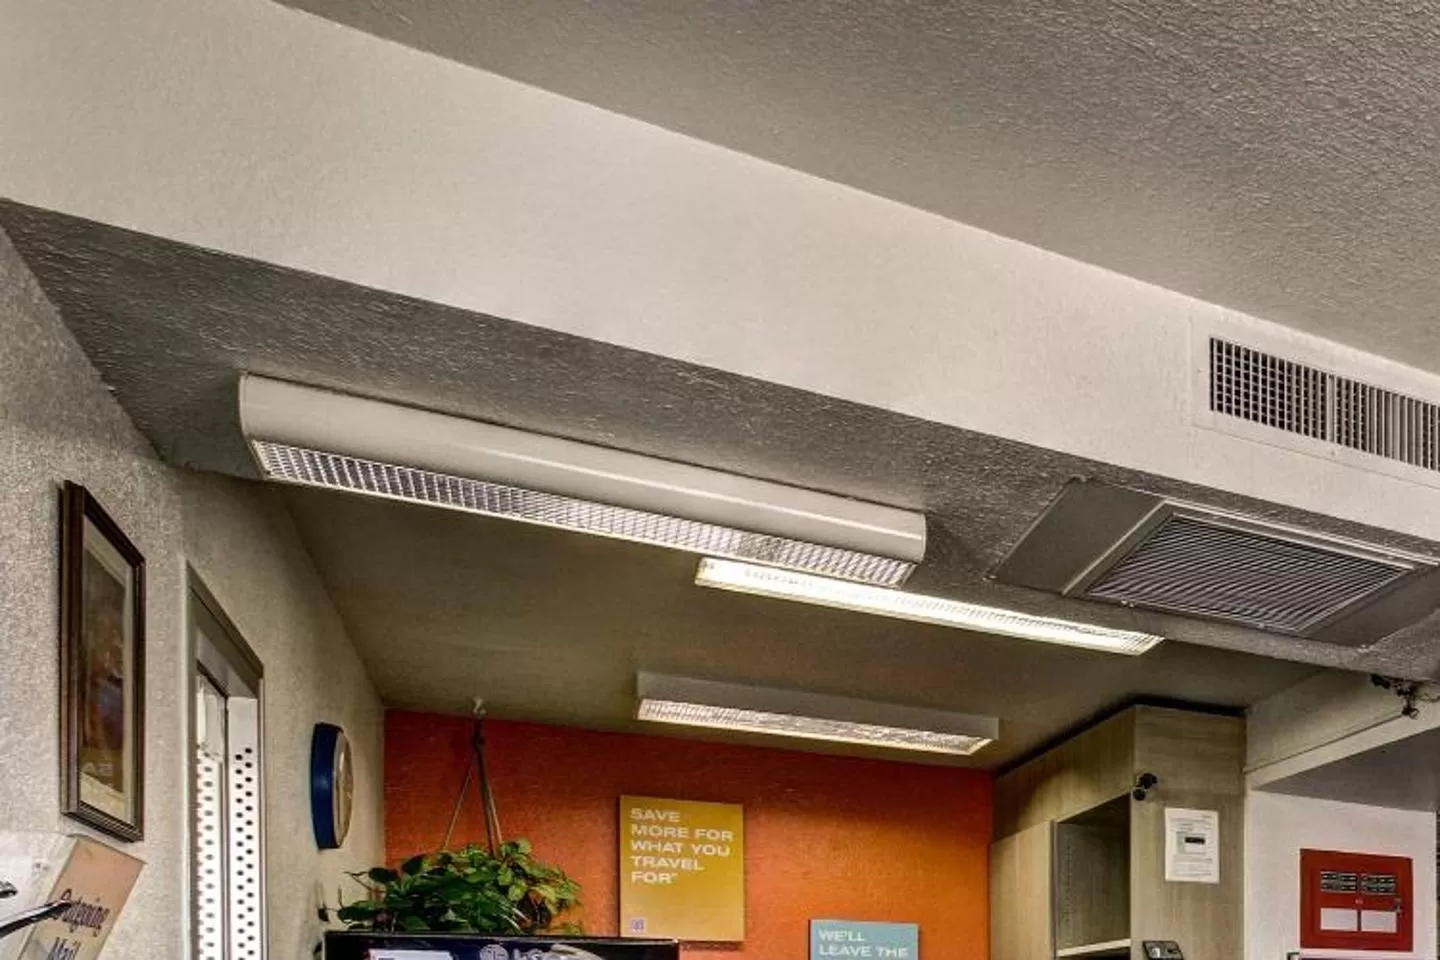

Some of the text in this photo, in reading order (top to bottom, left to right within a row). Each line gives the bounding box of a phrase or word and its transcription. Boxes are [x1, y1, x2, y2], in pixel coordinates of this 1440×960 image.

[631, 807, 680, 823] SAVE
[631, 823, 734, 842] MORE FOR
[630, 839, 731, 857] WHAT YOU
[630, 855, 704, 871] TRAVEL
[819, 929, 865, 942] WE'LL
[819, 943, 909, 958] LEAVE THE
